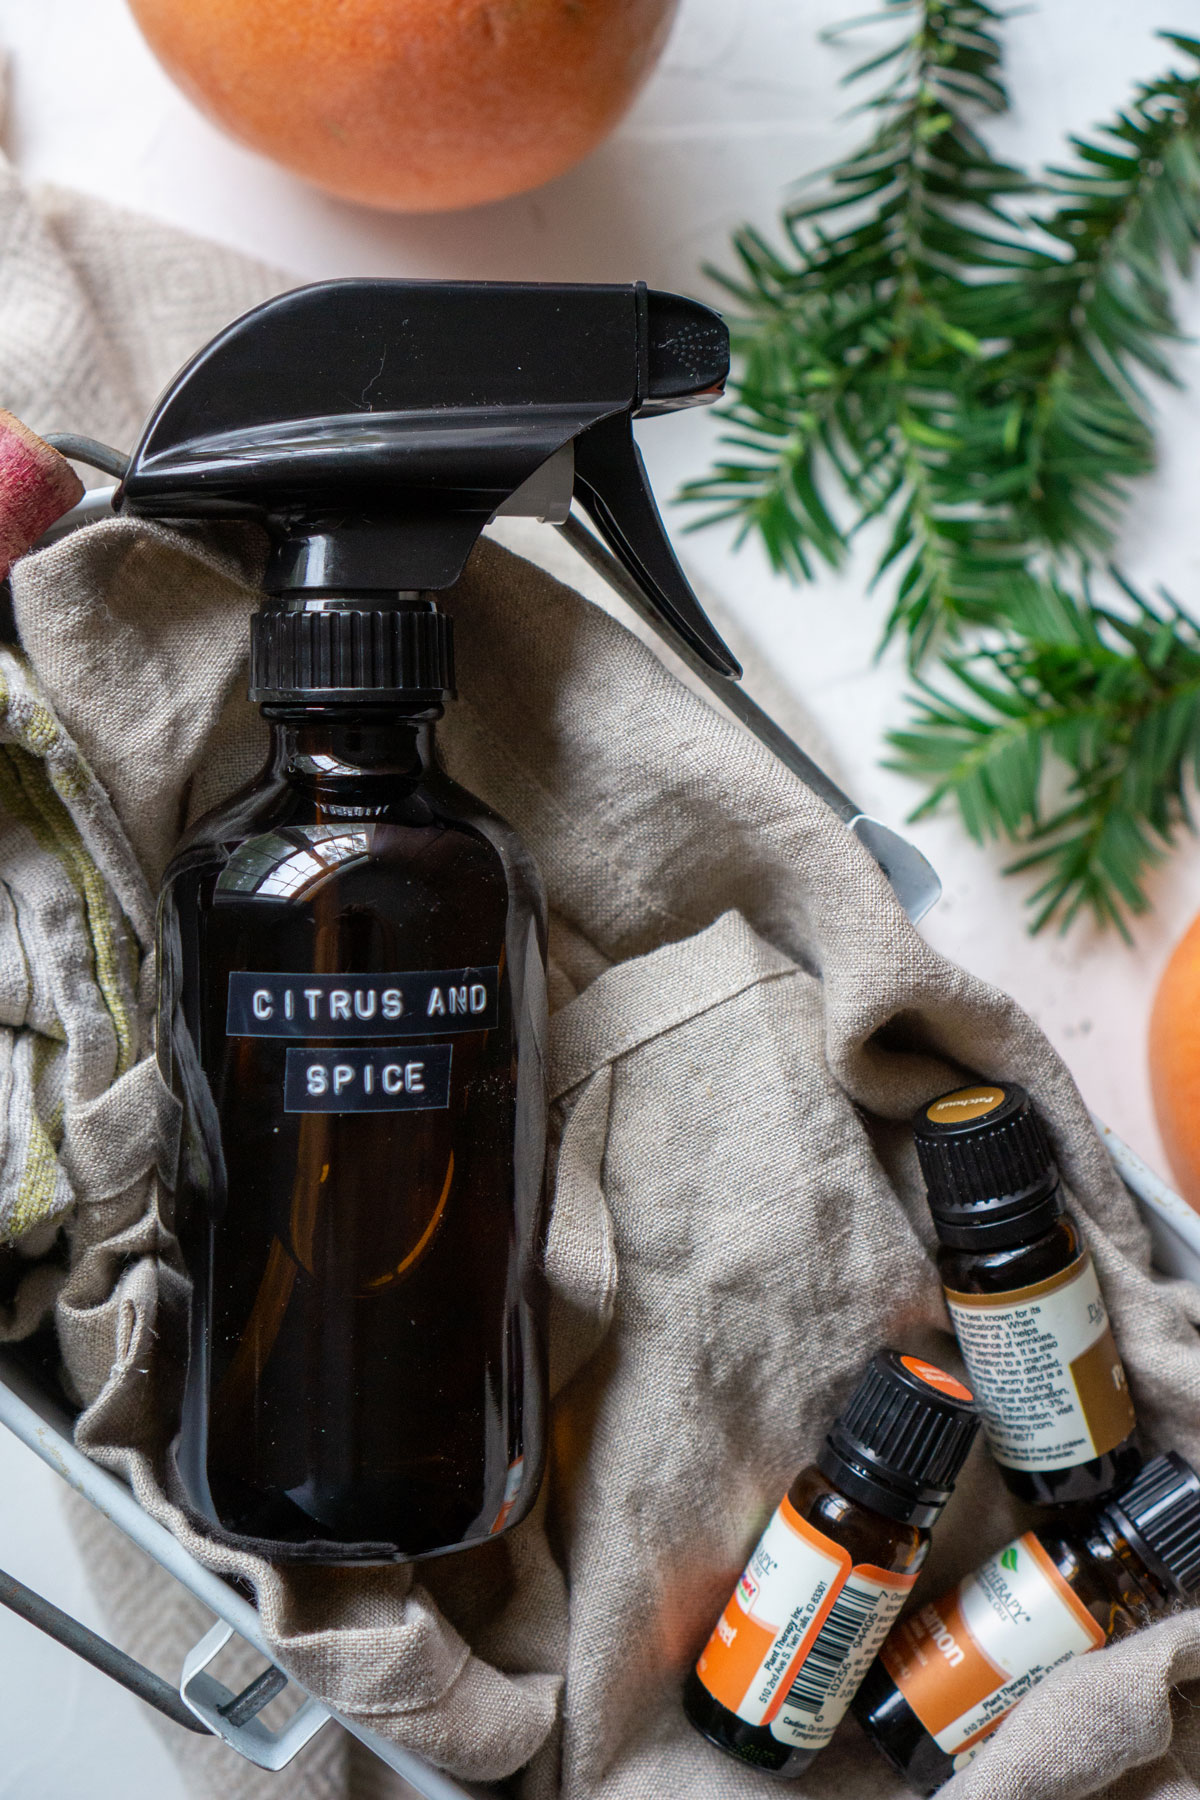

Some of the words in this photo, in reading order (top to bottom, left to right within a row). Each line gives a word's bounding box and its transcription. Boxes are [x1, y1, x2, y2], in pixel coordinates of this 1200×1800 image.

[252, 988, 404, 1021] CITRUS
[426, 984, 487, 1017] AND
[305, 1062, 427, 1097] SPICE
[984, 1313, 1013, 1322] known
[1015, 1310, 1027, 1319] for
[1030, 1306, 1041, 1315] its
[1007, 1318, 1035, 1329] When
[1013, 1327, 1038, 1338] helps
[1004, 1340, 1012, 1349] of
[1020, 1348, 1026, 1356] It
[1039, 1340, 1058, 1352] also
[996, 1368, 1021, 1376] When
[1001, 1378, 1024, 1387] worry
[1027, 1374, 1045, 1383] and
[1024, 1382, 1053, 1393] during
[1056, 1404, 1074, 1416] visit
[759, 1688, 772, 1704] 510
[767, 1673, 779, 1689] 2nd
[774, 1660, 787, 1676] Ave
[782, 1650, 792, 1660] S.
[787, 1634, 800, 1649] Twin
[795, 1615, 812, 1634] Falls,
[806, 1604, 816, 1613] ID
[811, 1581, 828, 1604] 83301
[764, 1650, 780, 1671] Plant
[775, 1620, 798, 1649] Therapy
[791, 1606, 804, 1620] Inc.
[814, 1714, 824, 1723] 6
[827, 1662, 852, 1698] 10256
[853, 1612, 879, 1649] 94406
[879, 1590, 888, 1598] 7
[982, 1694, 1002, 1711] Plant
[1001, 1673, 1032, 1696] Therapy
[1029, 1665, 1044, 1675] Inc.
[963, 1723, 978, 1736] 510
[977, 1713, 991, 1726] 2nd
[990, 1704, 1004, 1717] Ave
